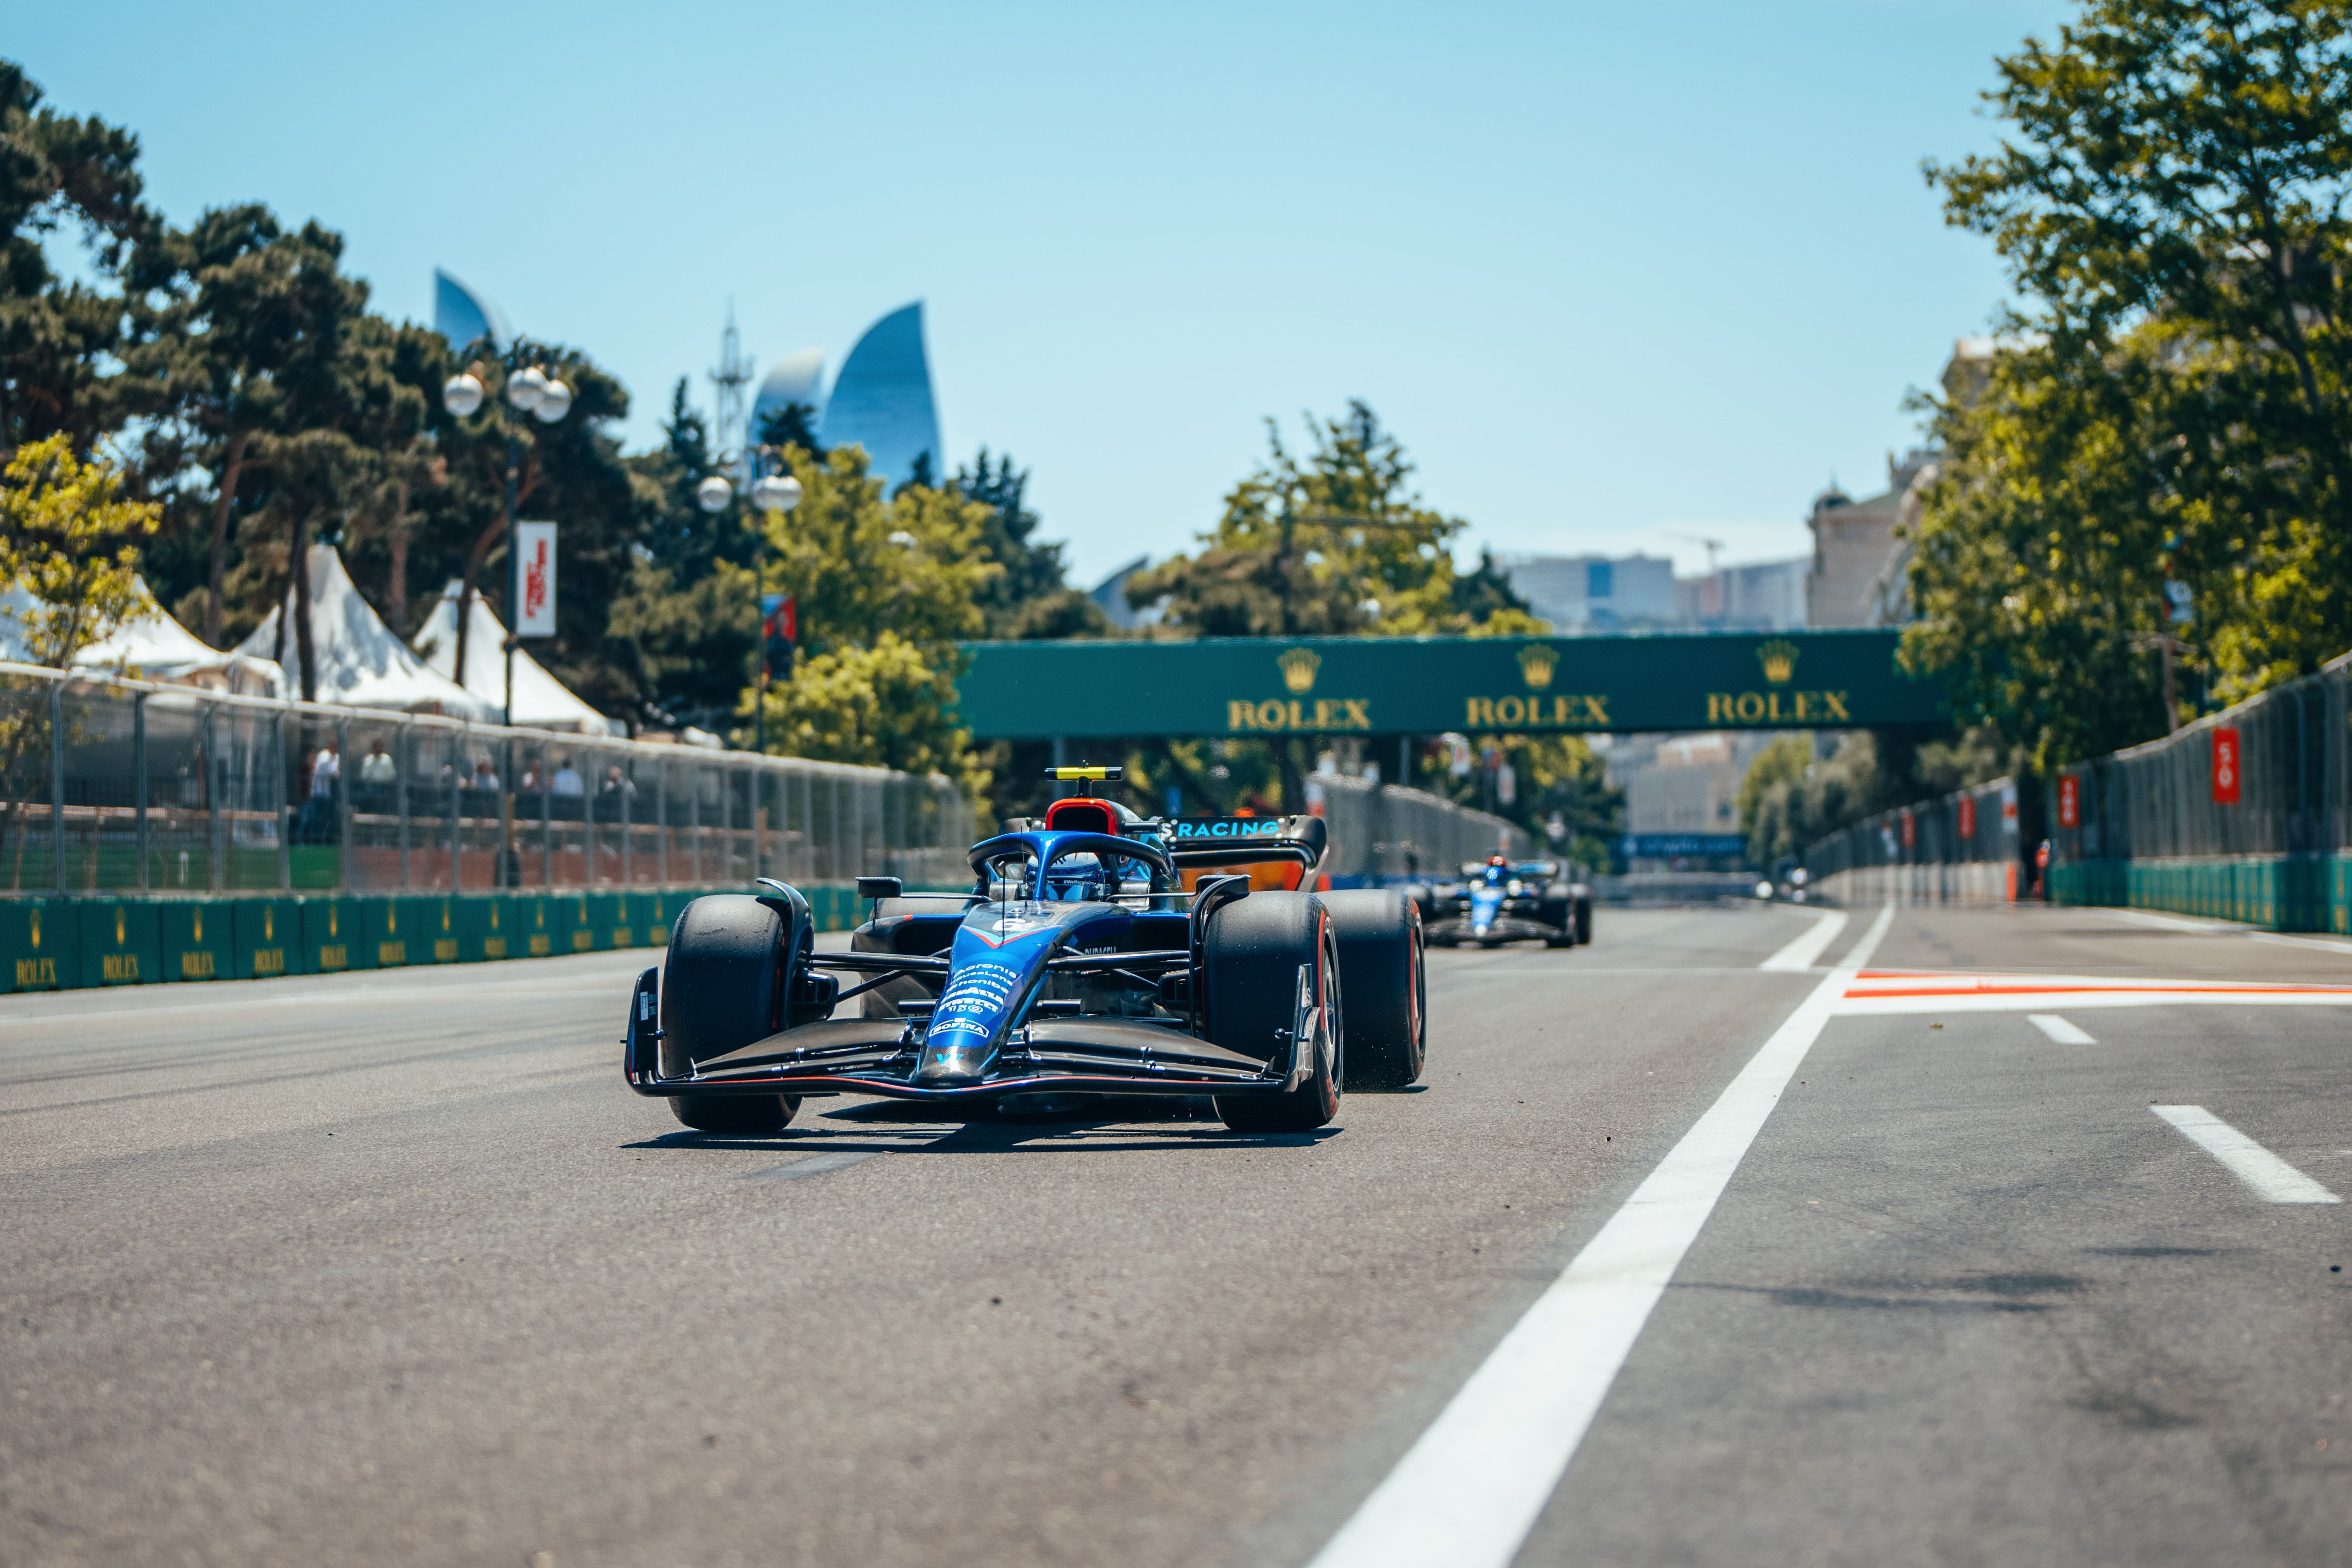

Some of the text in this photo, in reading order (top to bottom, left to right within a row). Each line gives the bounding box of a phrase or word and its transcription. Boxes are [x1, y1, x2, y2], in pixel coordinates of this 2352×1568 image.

[1227, 698, 1370, 730] ROLEX
[1466, 695, 1611, 727] ROLEX
[1708, 690, 1850, 723] ROLEX
[1177, 821, 1279, 837] RACING
[16, 957, 56, 987] ROLEX
[103, 954, 139, 980] ROLEX
[953, 963, 1017, 978] Acronis
[933, 1023, 984, 1034] SOFINA
